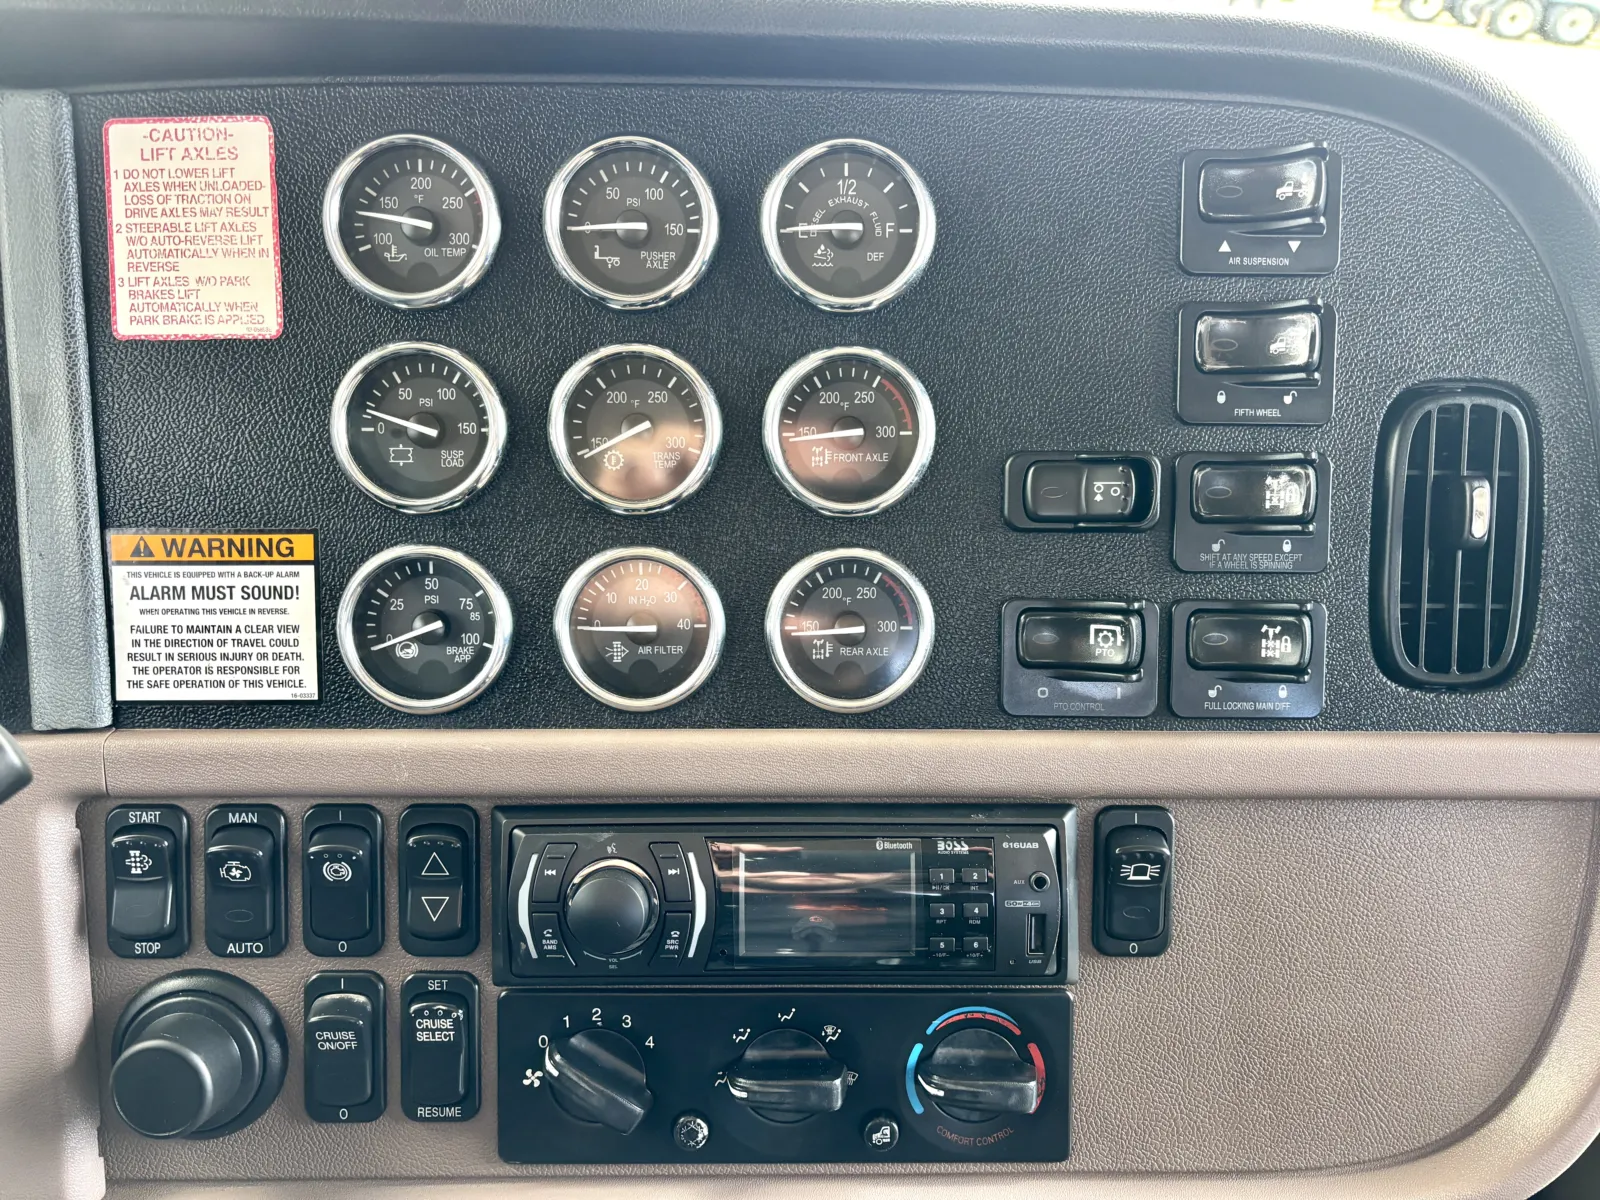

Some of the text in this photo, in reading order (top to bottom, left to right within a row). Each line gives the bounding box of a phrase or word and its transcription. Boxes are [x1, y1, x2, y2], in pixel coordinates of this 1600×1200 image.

[141, 146, 238, 161] LIFT AXLES
[124, 168, 235, 179] DO NOT LOWER LIFT
[124, 181, 196, 192] AXLES WHEN
[411, 177, 431, 189] 200
[837, 179, 857, 195] 1/2
[606, 187, 620, 199] 50
[645, 188, 663, 200] 100
[379, 197, 398, 209] 150
[442, 197, 463, 209] 250
[627, 198, 640, 206] PSI
[125, 207, 269, 218] DRIVE AXLES MAY RESULT
[828, 196, 882, 237] EXHAUST FLUID
[126, 222, 256, 233] STEERABLE LIFT AXLES
[665, 224, 683, 235] 150
[886, 223, 895, 238] F
[126, 235, 263, 246] W/O AUTO-REVERSE LIFT
[374, 233, 392, 244] 100
[449, 233, 469, 245] 300
[424, 248, 467, 257] OIL TEMP
[641, 252, 675, 260] PUSHER
[867, 253, 884, 261] DEF
[128, 261, 179, 272] REVERSE
[646, 261, 668, 269] AXLE
[1228, 257, 1290, 266] AIR SUSPENSION
[129, 289, 200, 300] BRAKES LIFT
[399, 388, 412, 400] 50
[437, 388, 456, 400] 100
[606, 392, 627, 404] 200
[648, 392, 668, 404] 250
[819, 392, 840, 404] 200
[854, 392, 875, 404] 250
[420, 398, 433, 407] PSI
[1234, 408, 1281, 417] FIFTH WHEEL
[458, 423, 476, 435] 150
[876, 426, 895, 438] 300
[666, 437, 685, 448] 300
[441, 451, 464, 459] SUSP
[653, 452, 680, 460] TRANS
[834, 453, 888, 462] FRONT AXLE
[441, 459, 464, 467] LOAD
[162, 538, 294, 558] WARNING
[1200, 553, 1220, 561] SHIFT
[1224, 561, 1248, 569] WHEEL
[425, 578, 439, 590] 50
[636, 579, 648, 590] 20
[130, 586, 299, 600] ALARM MUST SOUND!
[606, 593, 617, 603] 10
[664, 592, 677, 602] 30
[822, 587, 842, 598] 200
[857, 587, 877, 598] 250
[390, 599, 404, 610] 25
[425, 595, 439, 604] PSI
[460, 598, 473, 609] 75
[470, 612, 480, 620] 85
[130, 625, 299, 634] FAILURE MAINTAIN CLEAR VIEW
[677, 619, 690, 630] 40
[877, 621, 897, 632] 300
[144, 638, 299, 647] THE DIRECTION TRAVEL COULD
[461, 634, 479, 645] 100
[447, 647, 474, 655] BRAKE
[638, 646, 683, 654] AIR FILTER
[840, 648, 889, 656] REAR AXLE
[1095, 648, 1115, 656] PTO
[128, 652, 304, 661] RESULT SERIOUS INJURY DEATH.
[454, 655, 471, 663] APP
[132, 666, 300, 675] THE OPERATOR RESPONSIBLE FOR
[127, 680, 306, 688] THE SAFE OPERATION THIS VEHICLE.
[1204, 702, 1273, 710] FULL LOCKING MAIN
[128, 812, 161, 823] START
[228, 813, 258, 823] MAN
[134, 942, 161, 954] STOP
[227, 943, 263, 954] AUTO
[428, 980, 448, 991] SET
[592, 1008, 602, 1020] 2
[416, 1019, 454, 1029] CRUISE
[563, 1016, 570, 1028] 1
[622, 1015, 632, 1027] 3
[316, 1032, 356, 1040] CRUISE
[416, 1032, 455, 1041] SELECT
[538, 1035, 548, 1048] 0
[318, 1042, 358, 1050] ON/OFF
[645, 1036, 655, 1048] 4
[417, 1107, 461, 1117] RESUME
[936, 1125, 1015, 1146] COMFORT CONTROL
